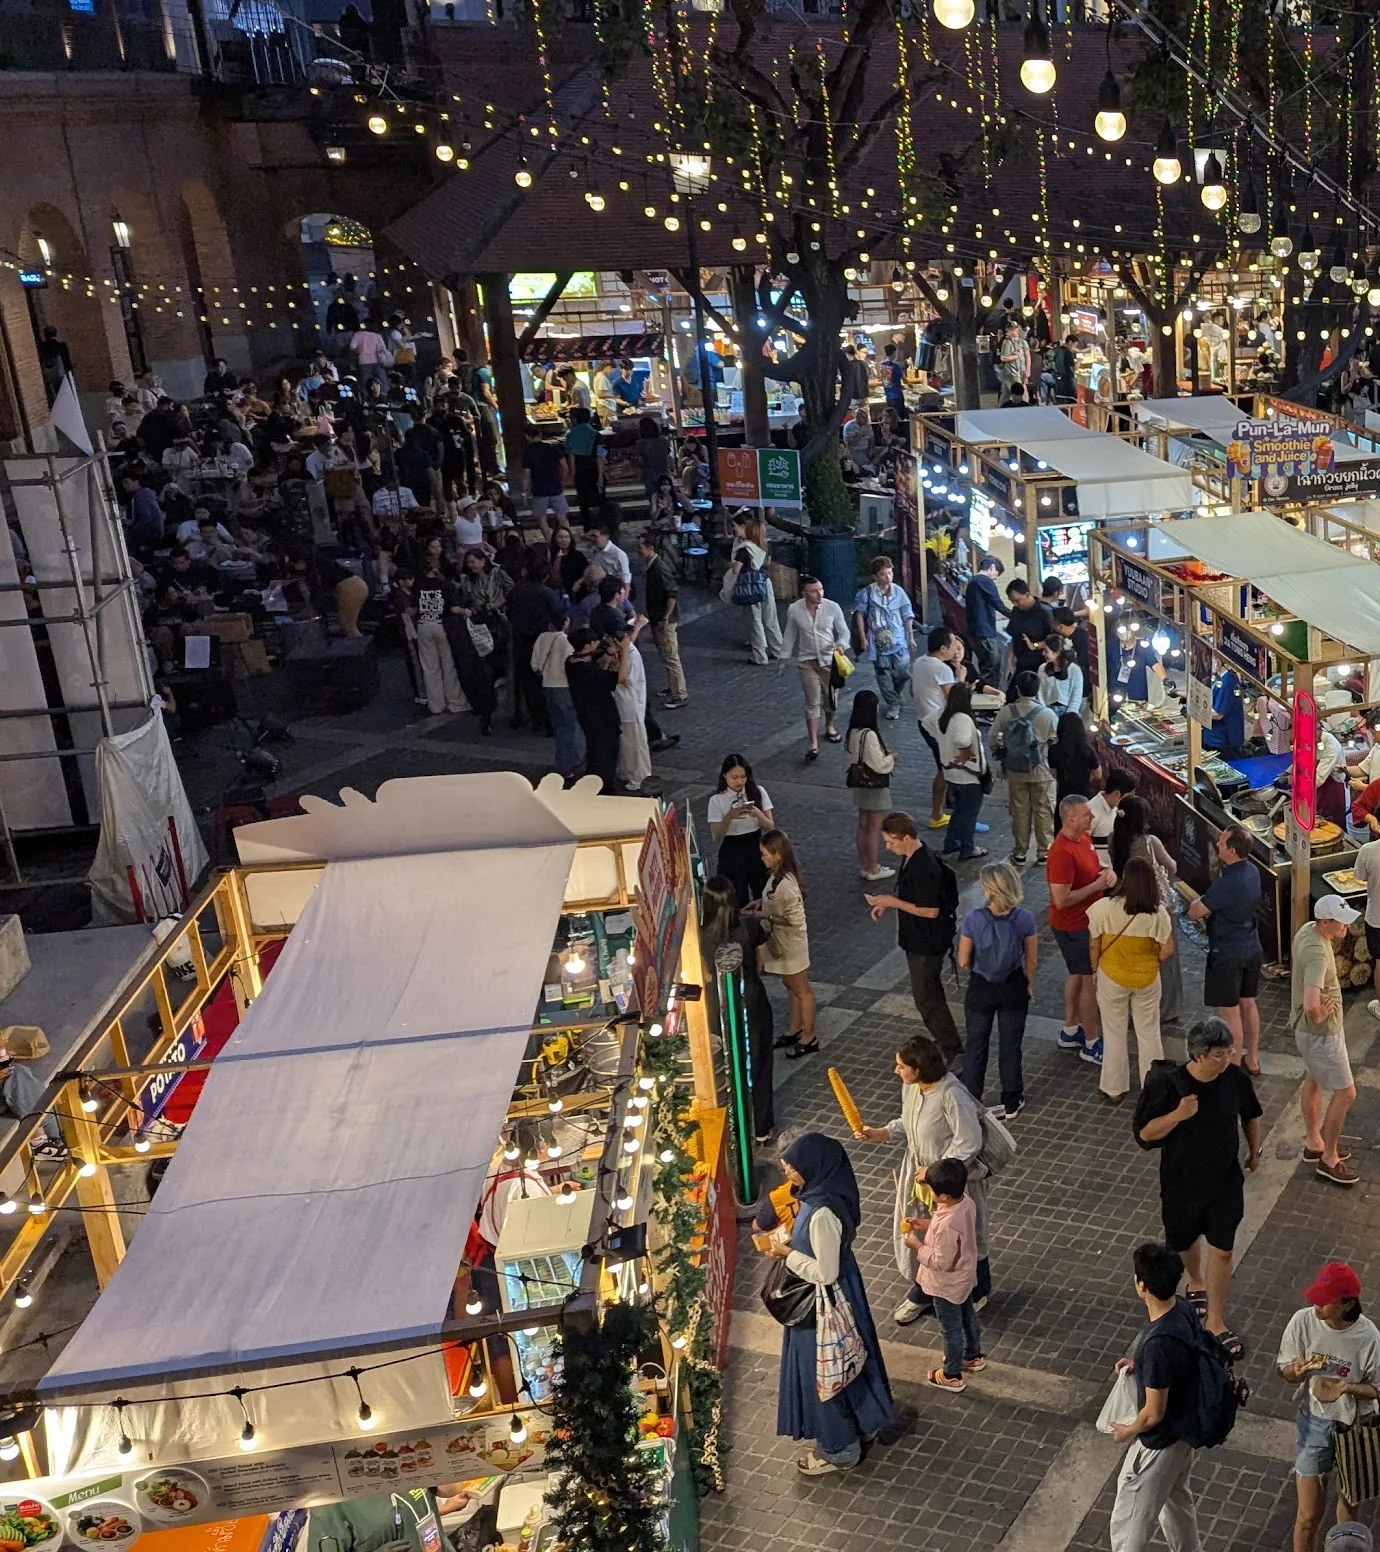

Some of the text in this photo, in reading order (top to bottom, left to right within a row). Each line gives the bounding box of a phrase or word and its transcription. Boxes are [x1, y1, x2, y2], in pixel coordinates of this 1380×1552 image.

[1237, 421, 1330, 437] Pun-La-Mun
[1253, 440, 1312, 453] Smoothie
[1255, 451, 1307, 464] and Juice
[1126, 580, 1148, 599] STUDIO
[67, 1485, 101, 1504] Menu
